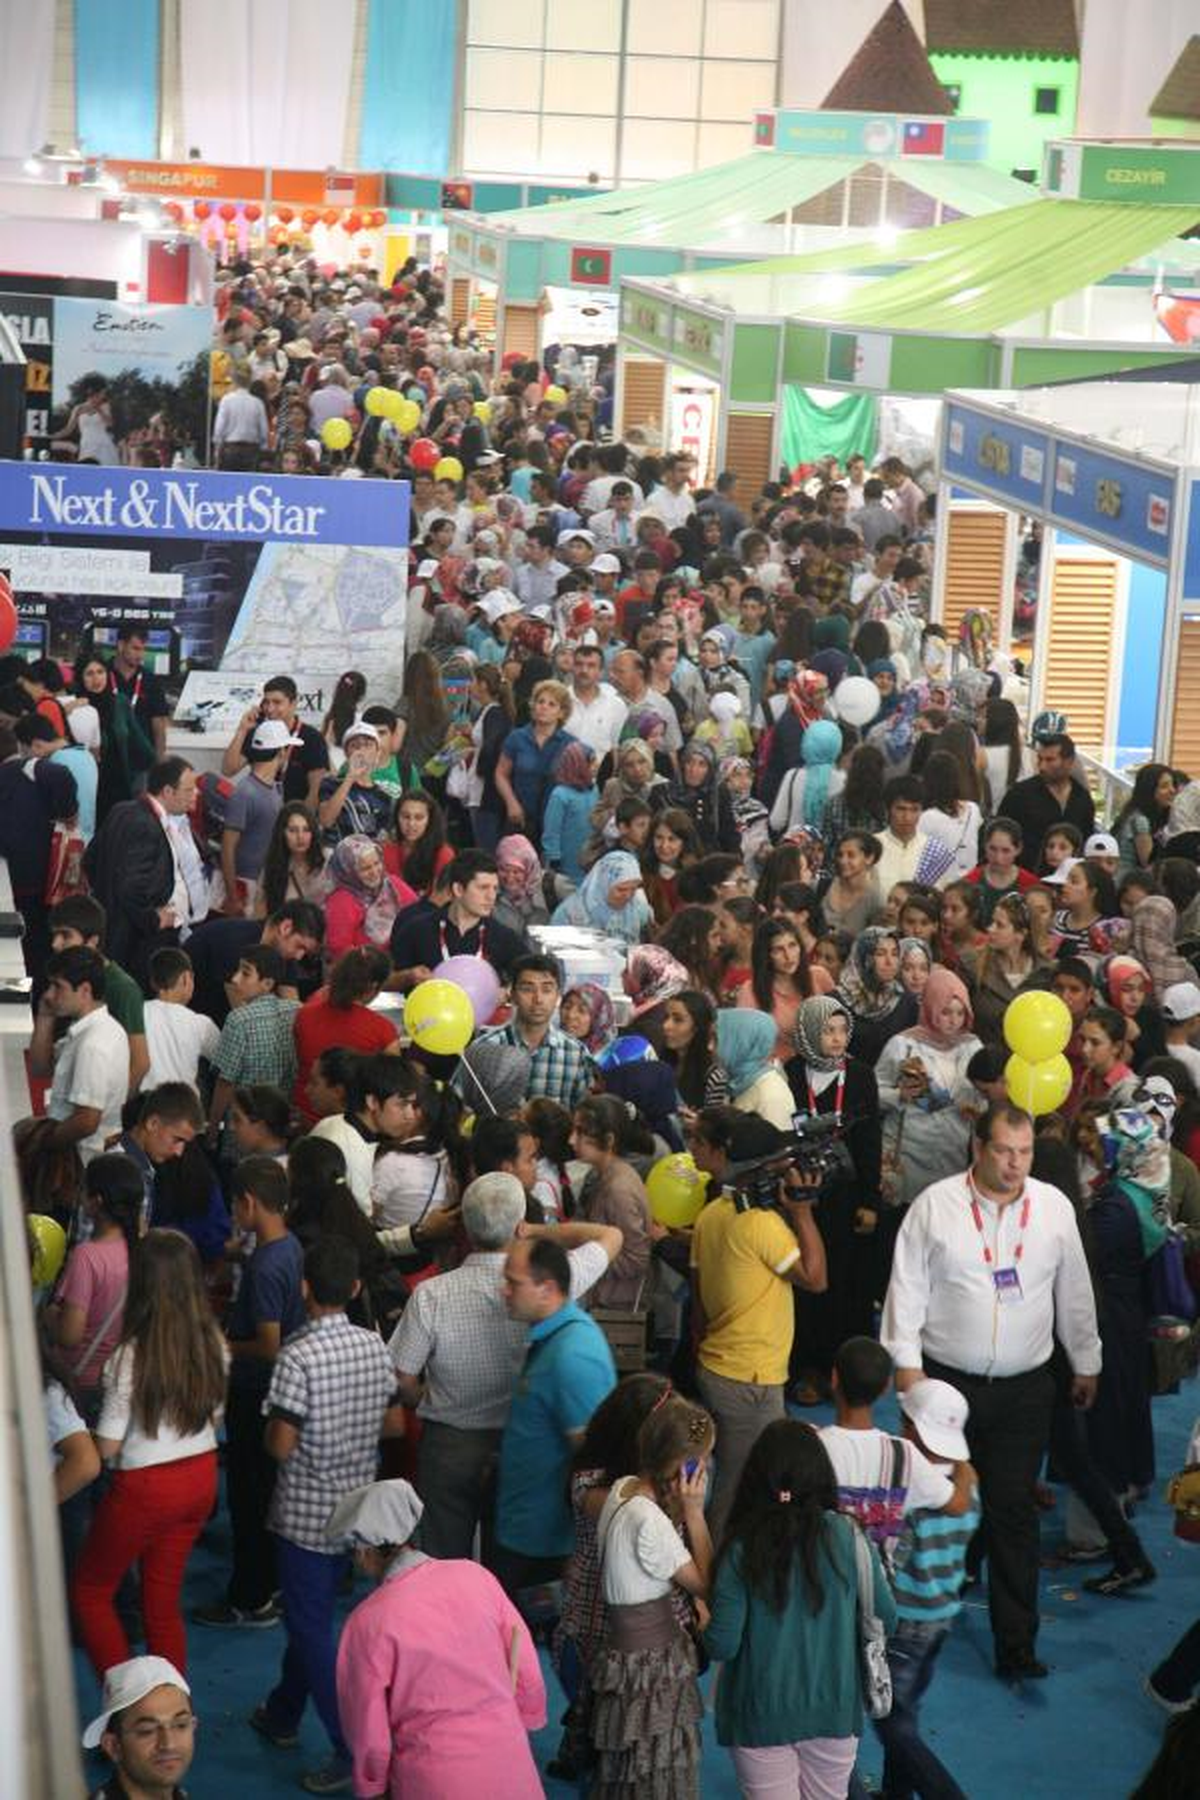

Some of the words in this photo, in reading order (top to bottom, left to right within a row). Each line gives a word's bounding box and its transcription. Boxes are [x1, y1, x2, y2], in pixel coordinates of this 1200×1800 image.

[29, 475, 116, 526] Next
[120, 479, 158, 528] &
[162, 481, 326, 536] NextStar
